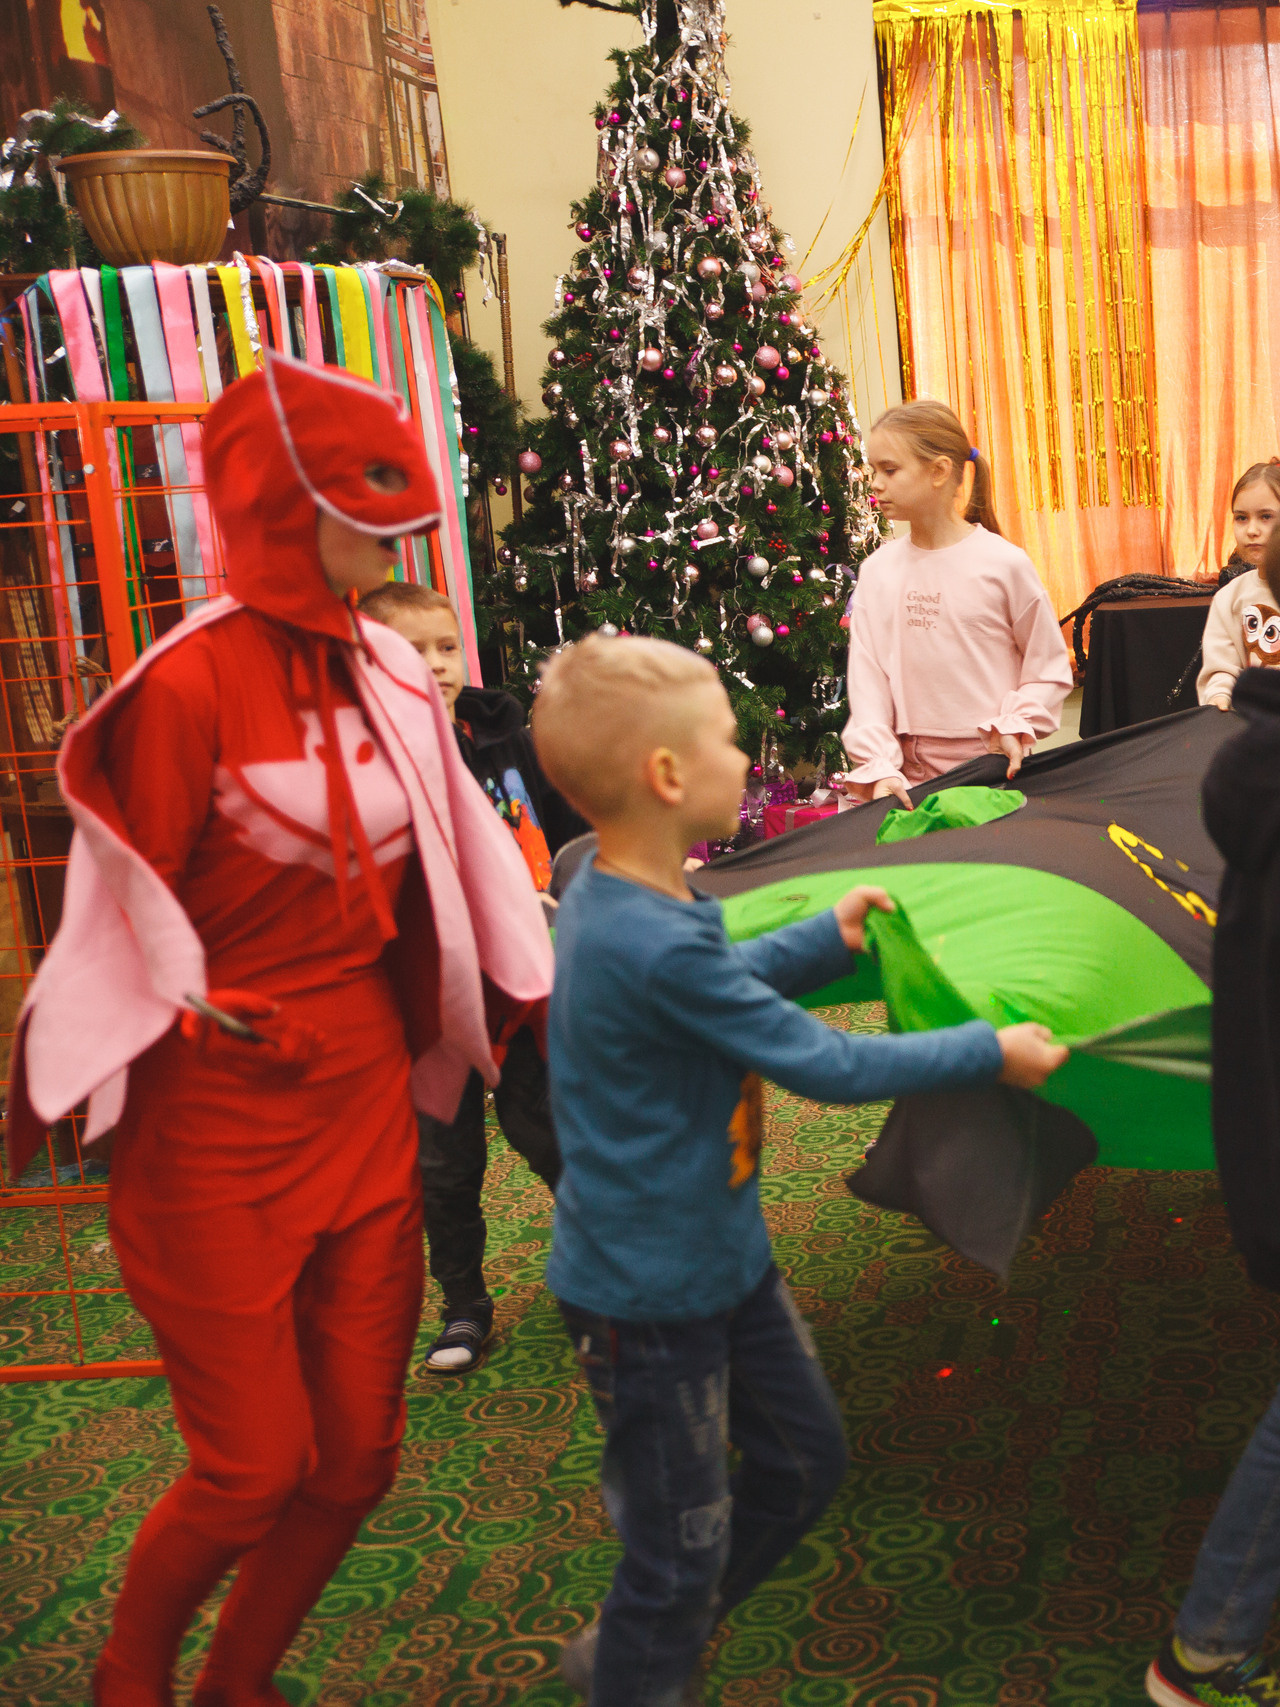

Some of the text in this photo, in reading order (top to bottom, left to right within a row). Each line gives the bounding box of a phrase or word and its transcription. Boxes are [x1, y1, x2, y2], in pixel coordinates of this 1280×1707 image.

[906, 590, 941, 605] Good
[905, 603, 941, 617] vibes
[906, 616, 937, 631] only.
